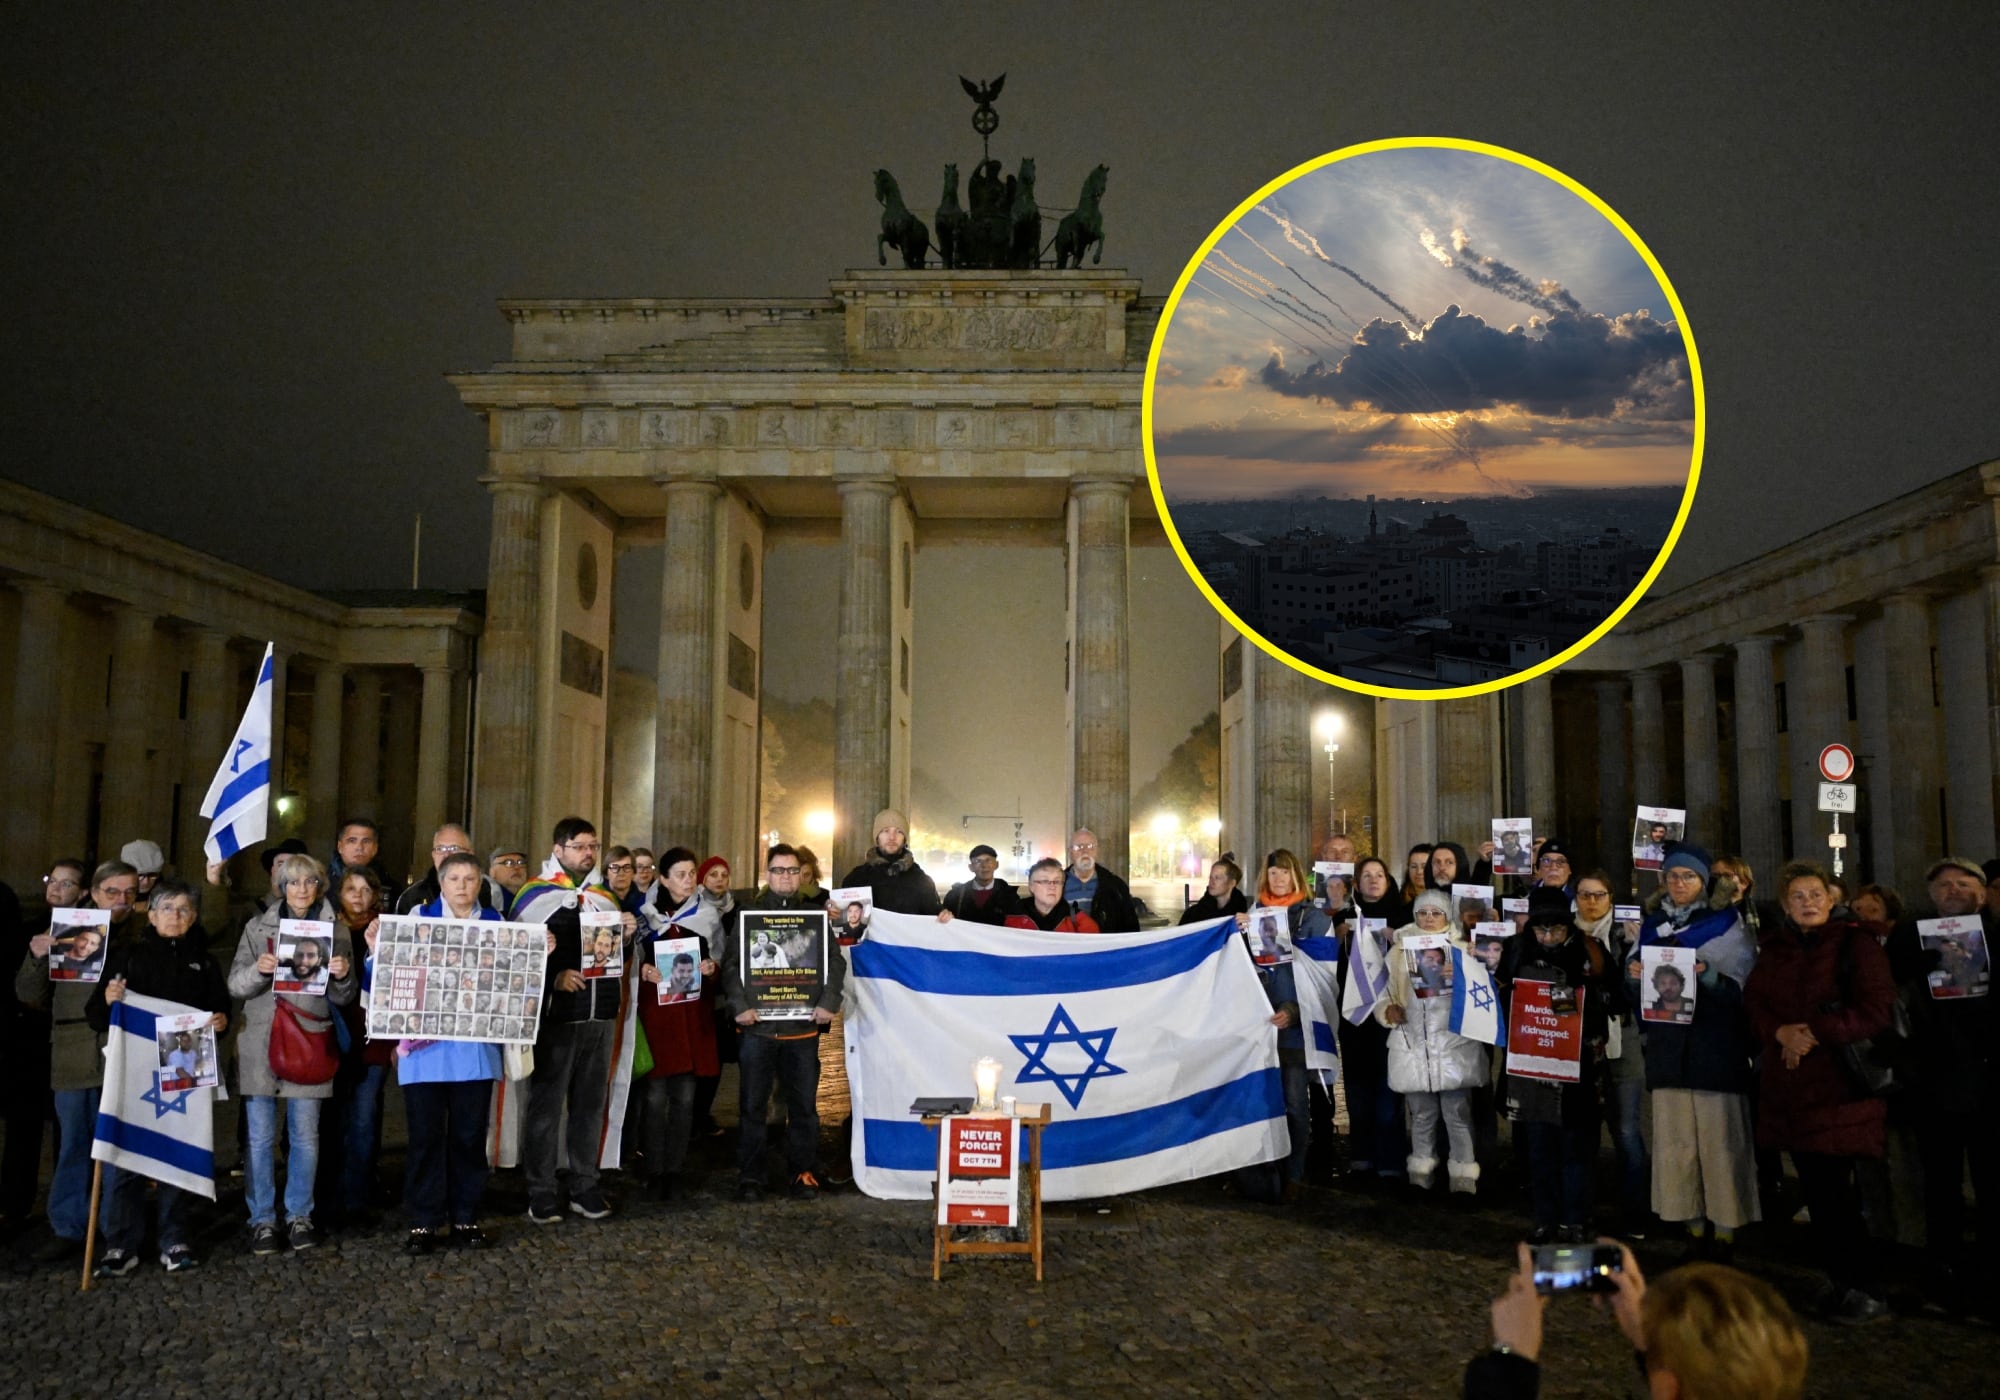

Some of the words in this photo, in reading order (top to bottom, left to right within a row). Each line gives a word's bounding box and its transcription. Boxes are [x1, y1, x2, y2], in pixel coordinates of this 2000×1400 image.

[1831, 801, 1843, 809] frei
[395, 969, 419, 979] BRING
[394, 979, 417, 989] THEM
[393, 989, 416, 998] HOME
[391, 998, 417, 1010] NOW
[1524, 1004, 1554, 1016] Murde
[1534, 1016, 1558, 1027] 1.170
[1520, 1024, 1570, 1040] Kidnapped:
[1537, 1037, 1555, 1048] 251
[960, 1129, 1002, 1141] NEVER
[959, 1141, 1002, 1151] FORGET
